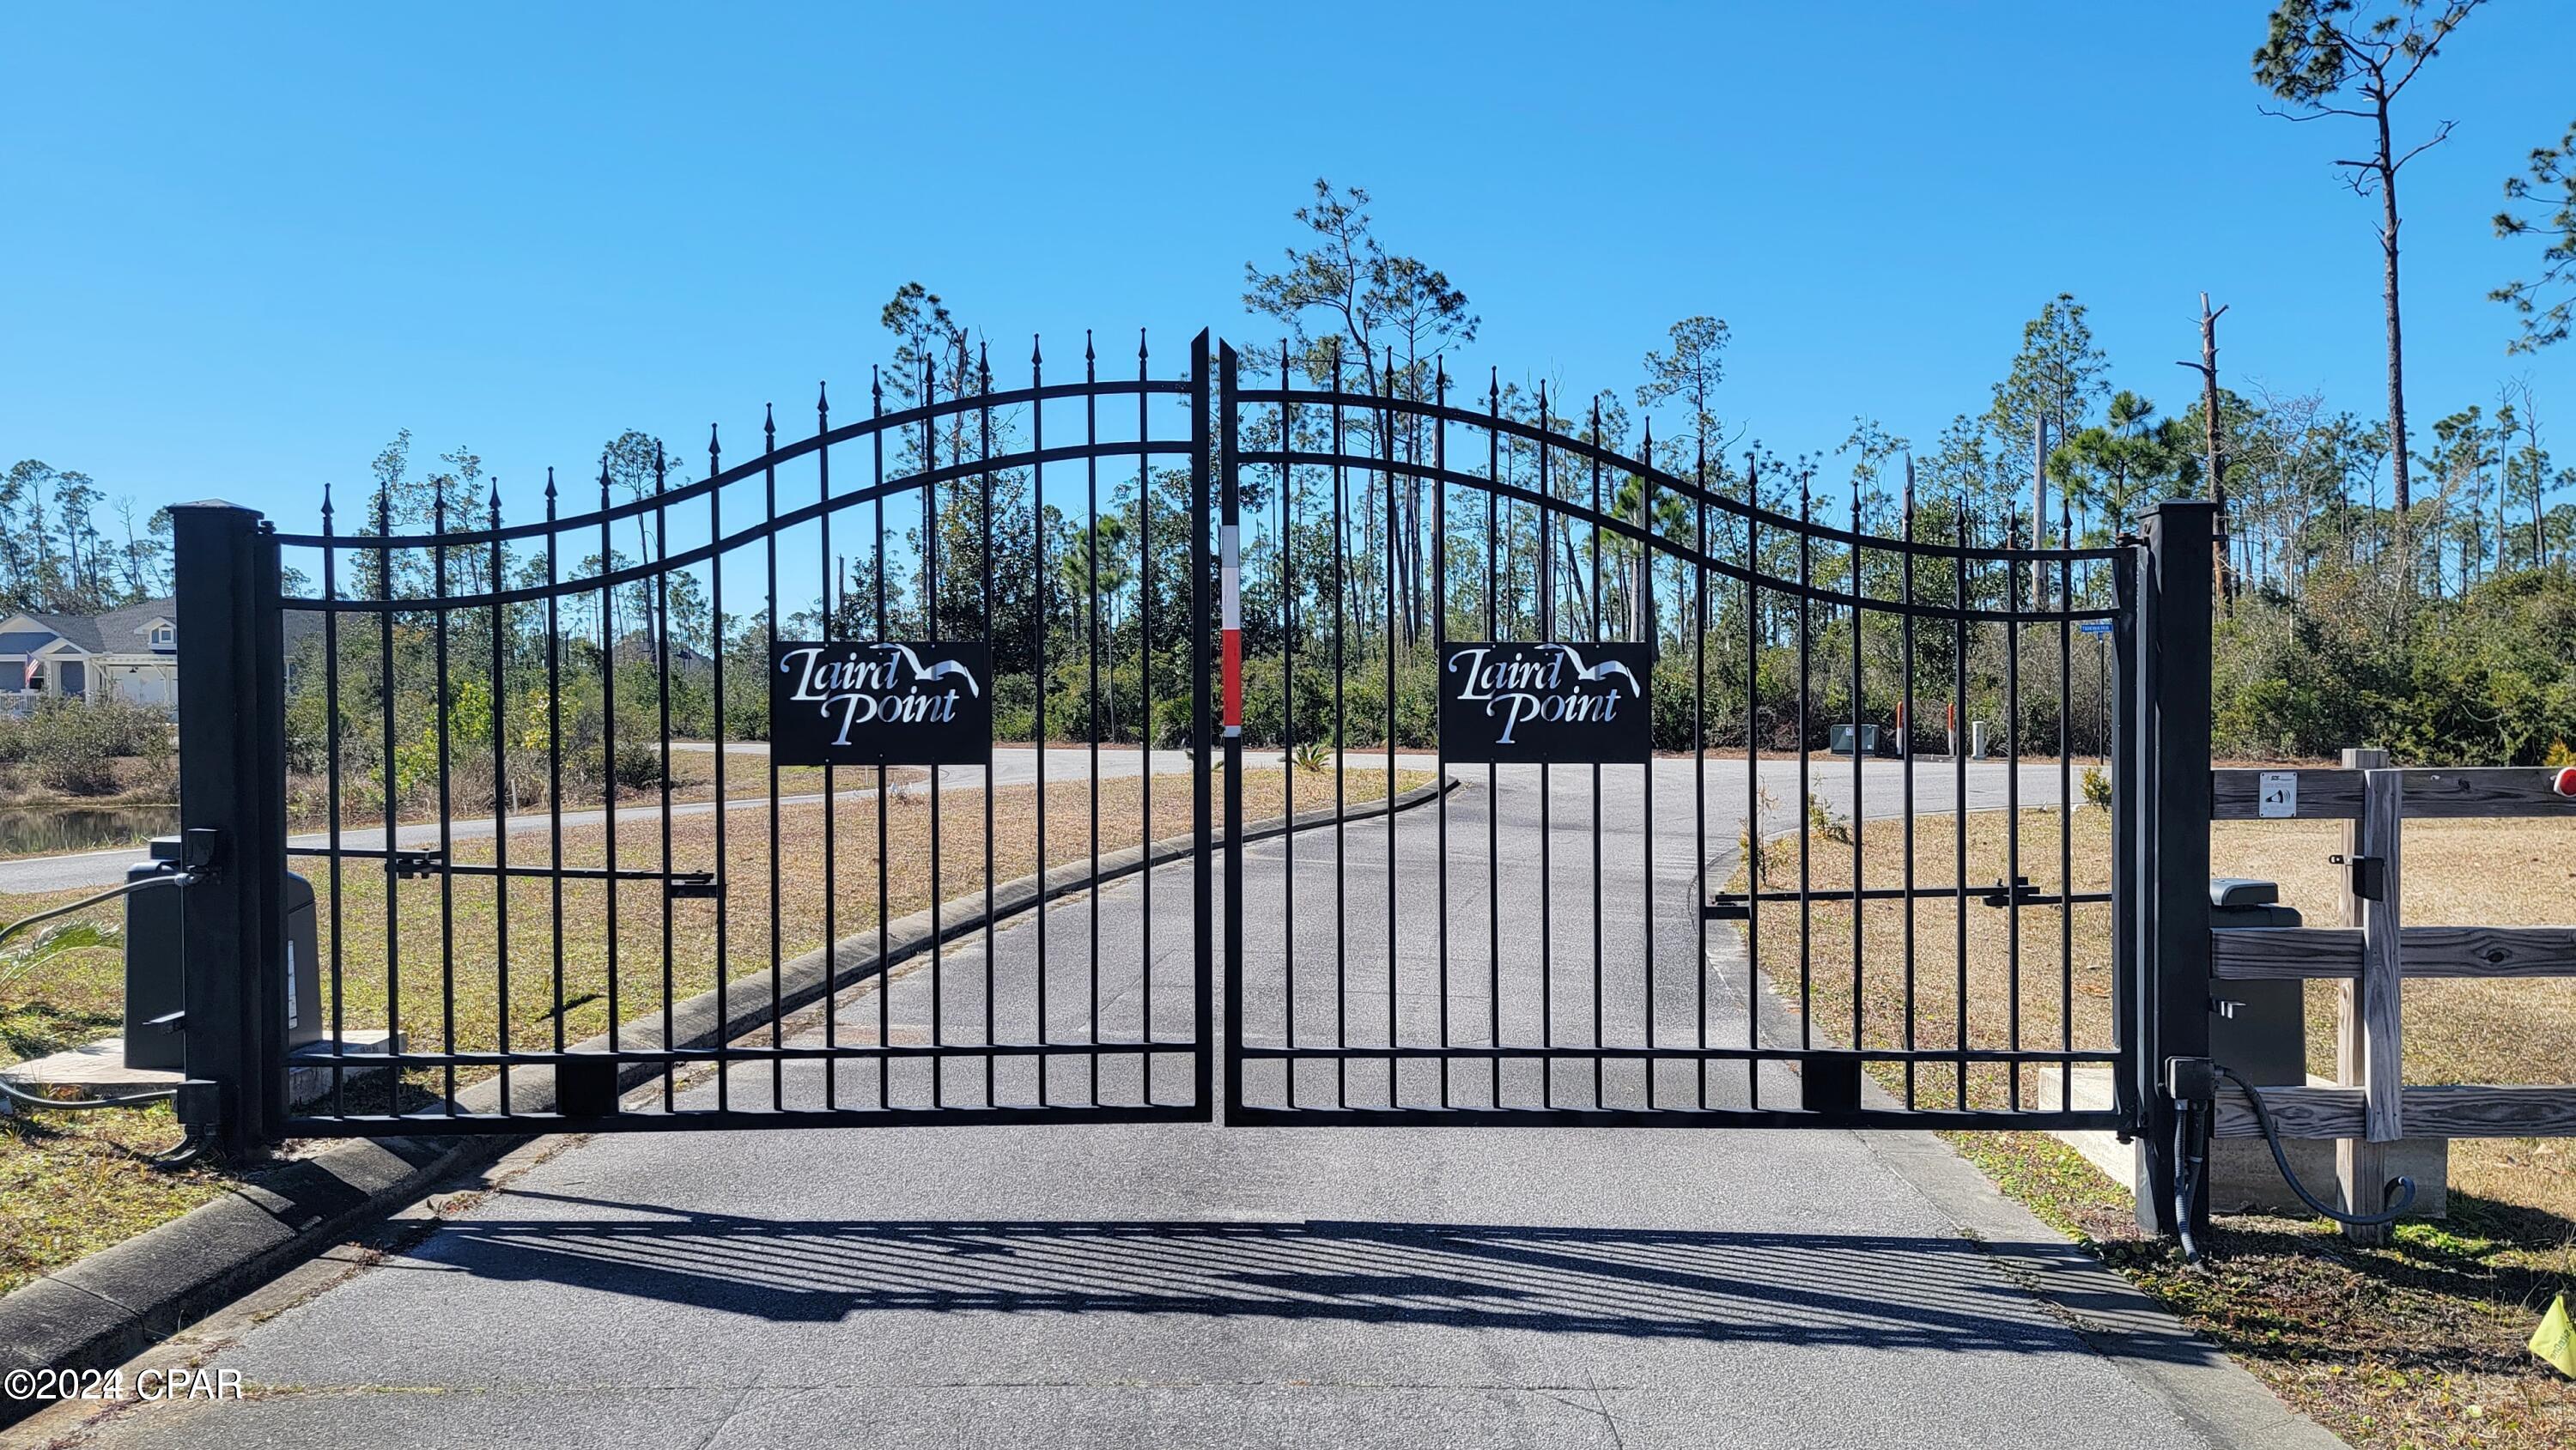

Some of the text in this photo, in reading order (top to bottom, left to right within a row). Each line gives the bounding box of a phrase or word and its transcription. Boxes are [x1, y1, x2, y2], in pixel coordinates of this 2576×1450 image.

[780, 647, 902, 701] Laird
[1448, 648, 1565, 700] Laird
[820, 685, 960, 746] Point
[1485, 685, 1622, 744] Point
